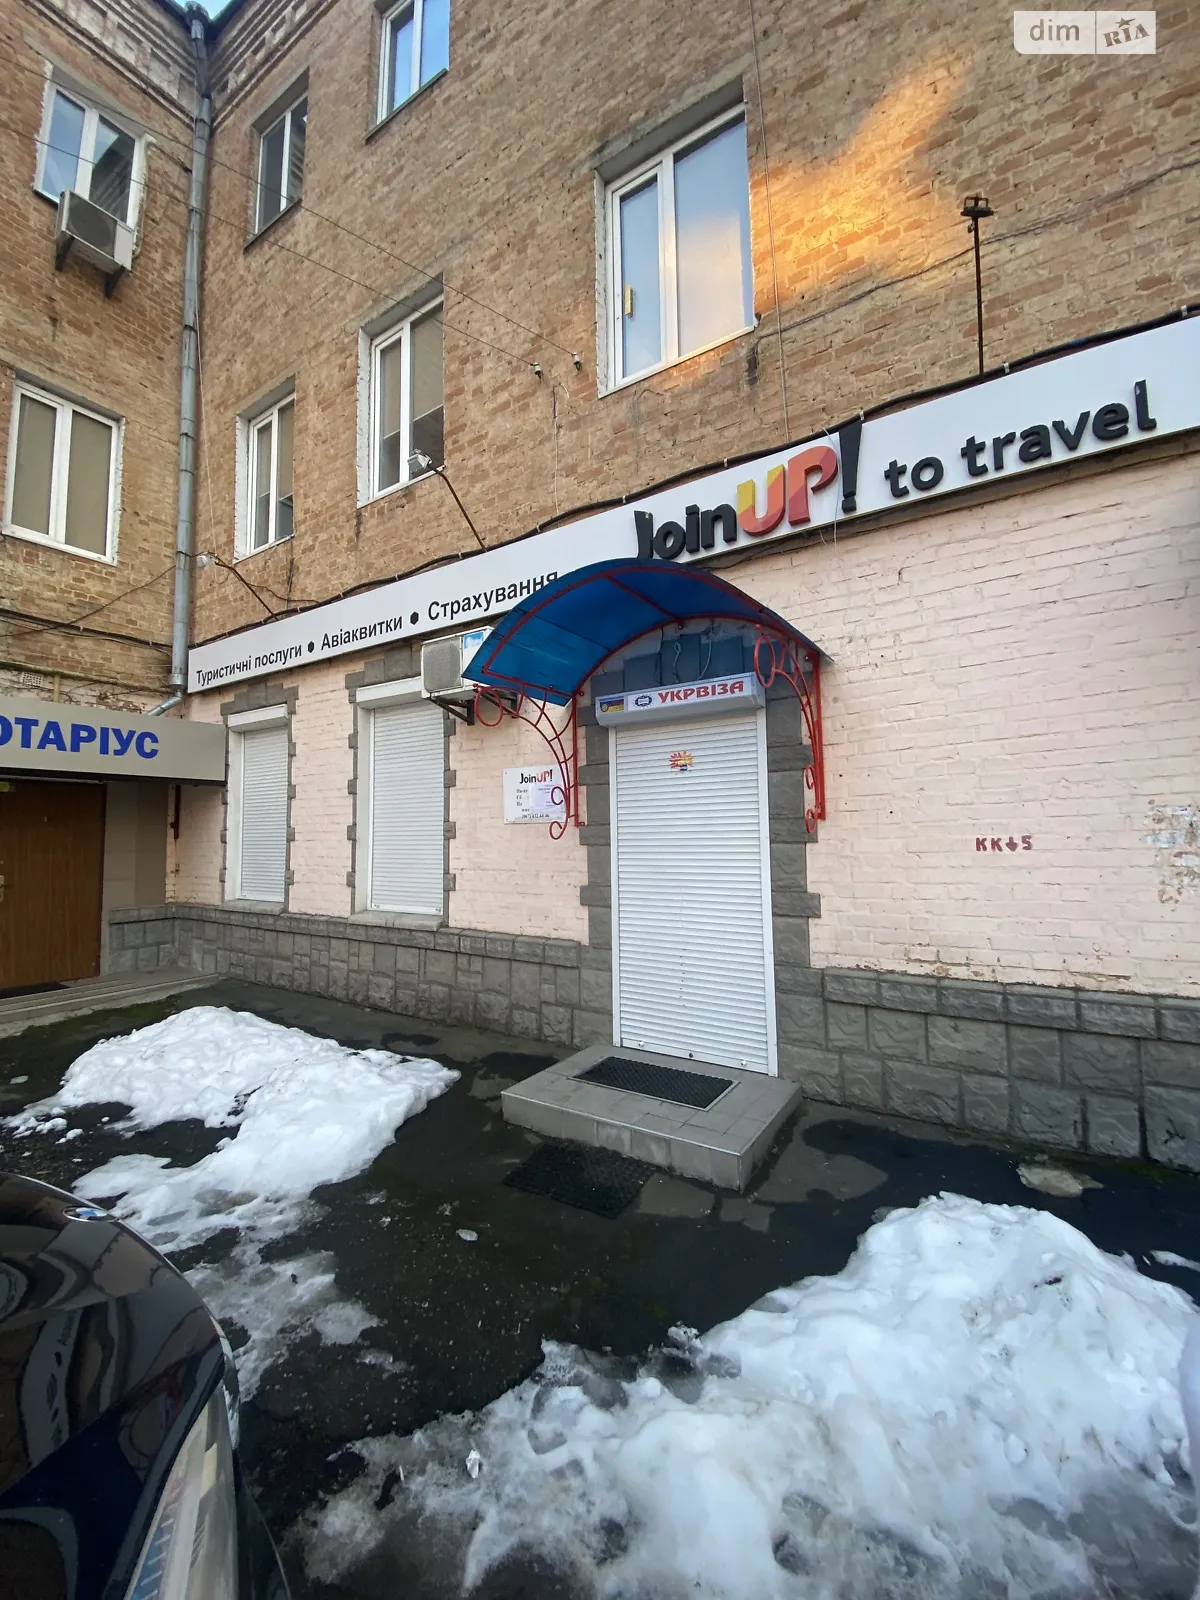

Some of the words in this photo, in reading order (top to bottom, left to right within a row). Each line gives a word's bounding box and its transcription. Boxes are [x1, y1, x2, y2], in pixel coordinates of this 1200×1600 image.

[884, 459, 944, 498] to
[961, 379, 1157, 477] travel
[196, 656, 252, 687] Туристичні
[254, 645, 302, 669] послуги
[321, 616, 402, 651] Авіаквитки
[658, 681, 744, 703] УКРВІЗА
